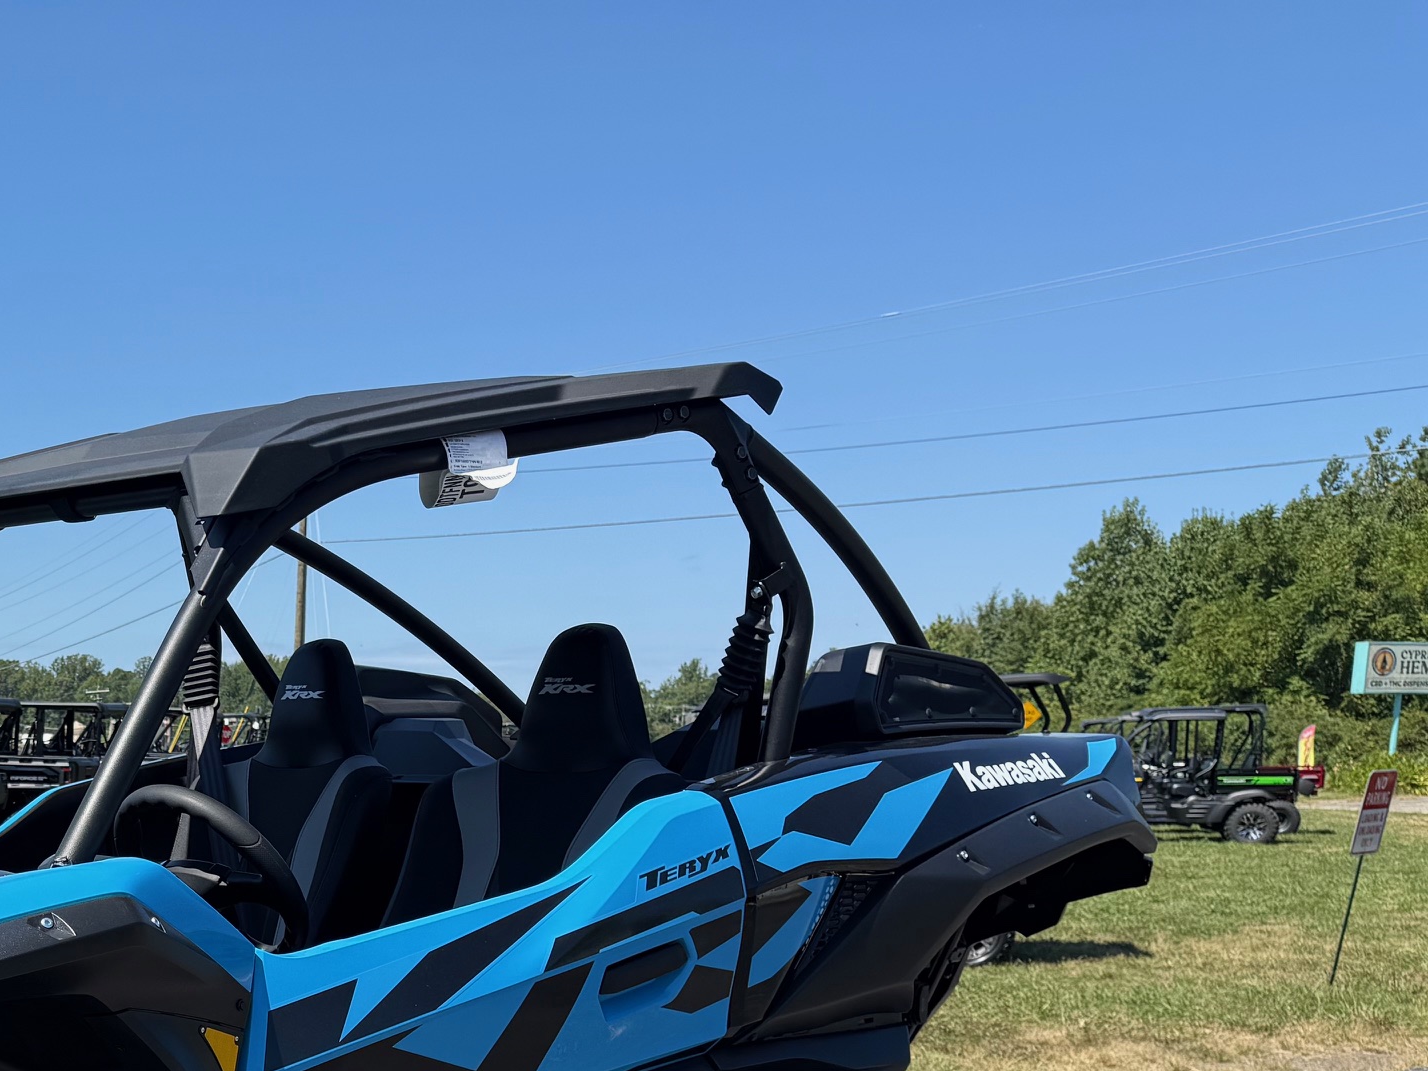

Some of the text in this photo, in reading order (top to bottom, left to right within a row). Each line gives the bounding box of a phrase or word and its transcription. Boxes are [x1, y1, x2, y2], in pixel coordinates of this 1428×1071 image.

[1400, 650, 1428, 660] CYPR
[538, 683, 597, 695] KRX
[280, 690, 326, 701] KRX
[952, 752, 1066, 792] Kawasaki
[639, 843, 731, 892] TERYX
